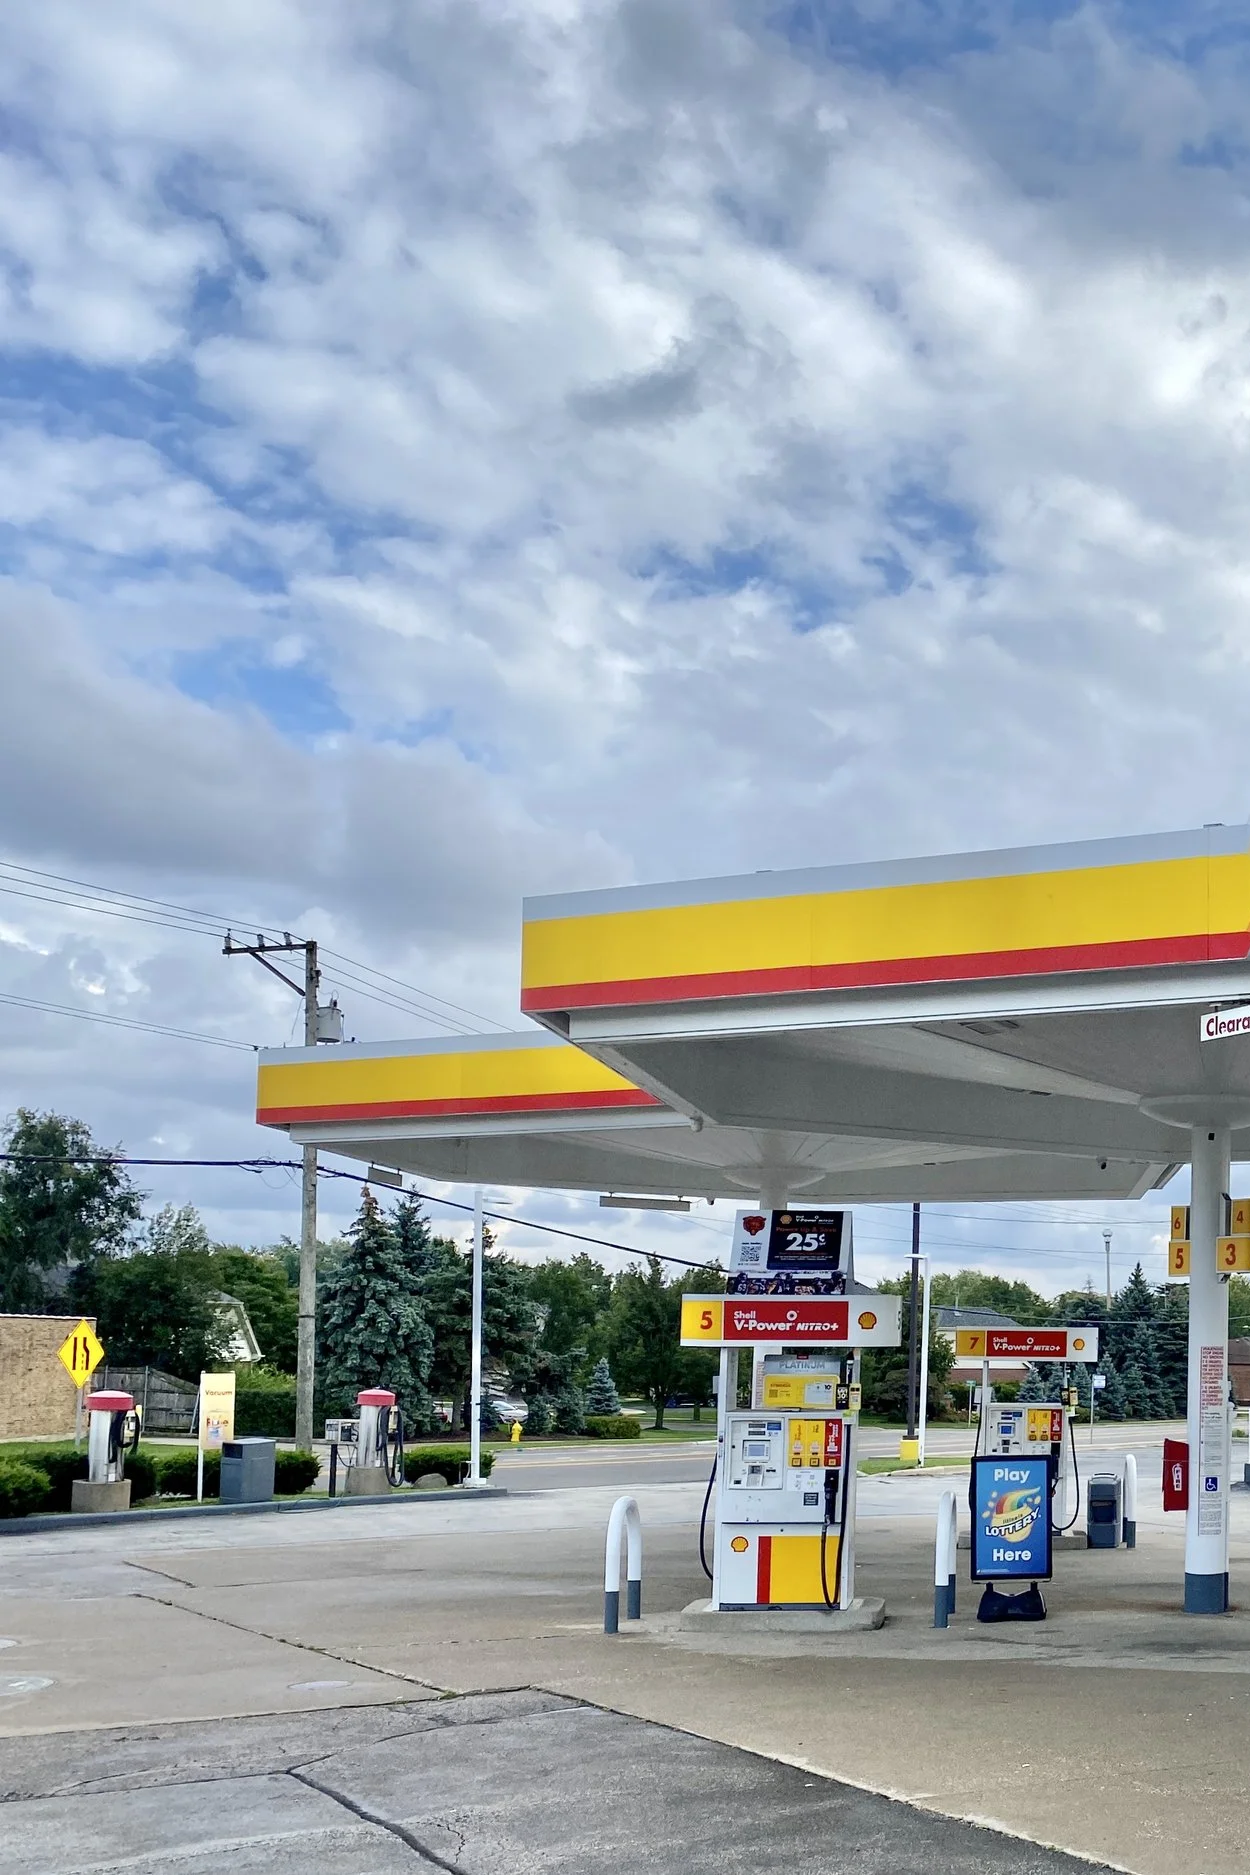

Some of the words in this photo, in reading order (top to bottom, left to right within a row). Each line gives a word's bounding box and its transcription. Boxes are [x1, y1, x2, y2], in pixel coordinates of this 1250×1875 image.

[1174, 1217, 1181, 1230] 6
[1236, 1211, 1244, 1224] 4
[1175, 1248, 1184, 1269] 5
[1225, 1244, 1236, 1266] 3
[700, 1310, 713, 1330] 5
[733, 1311, 756, 1320] Shell
[733, 1319, 793, 1331] V-Power
[796, 1322, 839, 1331] NITRO+
[970, 1337, 980, 1350] 7
[992, 1343, 1031, 1351] V-Power
[780, 1360, 825, 1369] PLATINUM
[994, 1468, 1030, 1484] Play
[985, 1507, 1040, 1537] LOTTERY
[993, 1548, 1032, 1561] Here
